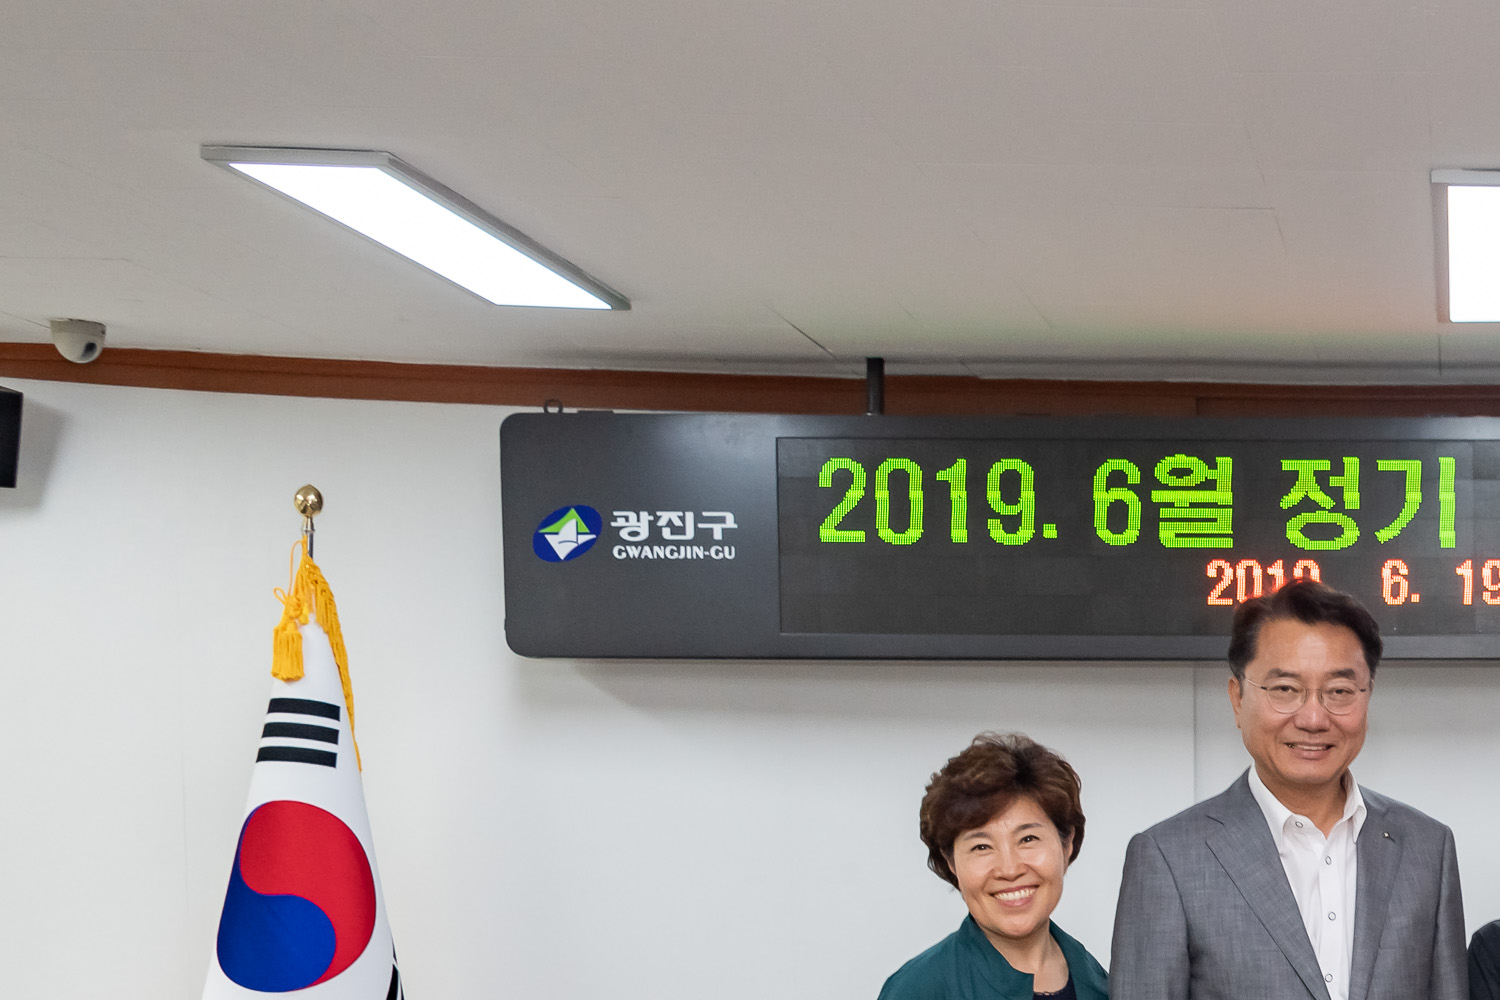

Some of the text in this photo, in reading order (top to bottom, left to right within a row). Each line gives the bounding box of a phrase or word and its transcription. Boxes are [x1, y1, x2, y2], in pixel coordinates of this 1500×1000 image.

[818, 457, 1058, 546] 2019.
[1092, 453, 1235, 549] 6월
[1279, 456, 1457, 551] 정기
[610, 510, 738, 542] 광진구
[612, 544, 736, 561] GWANGJIN-GU
[1380, 558, 1422, 606] 6.
